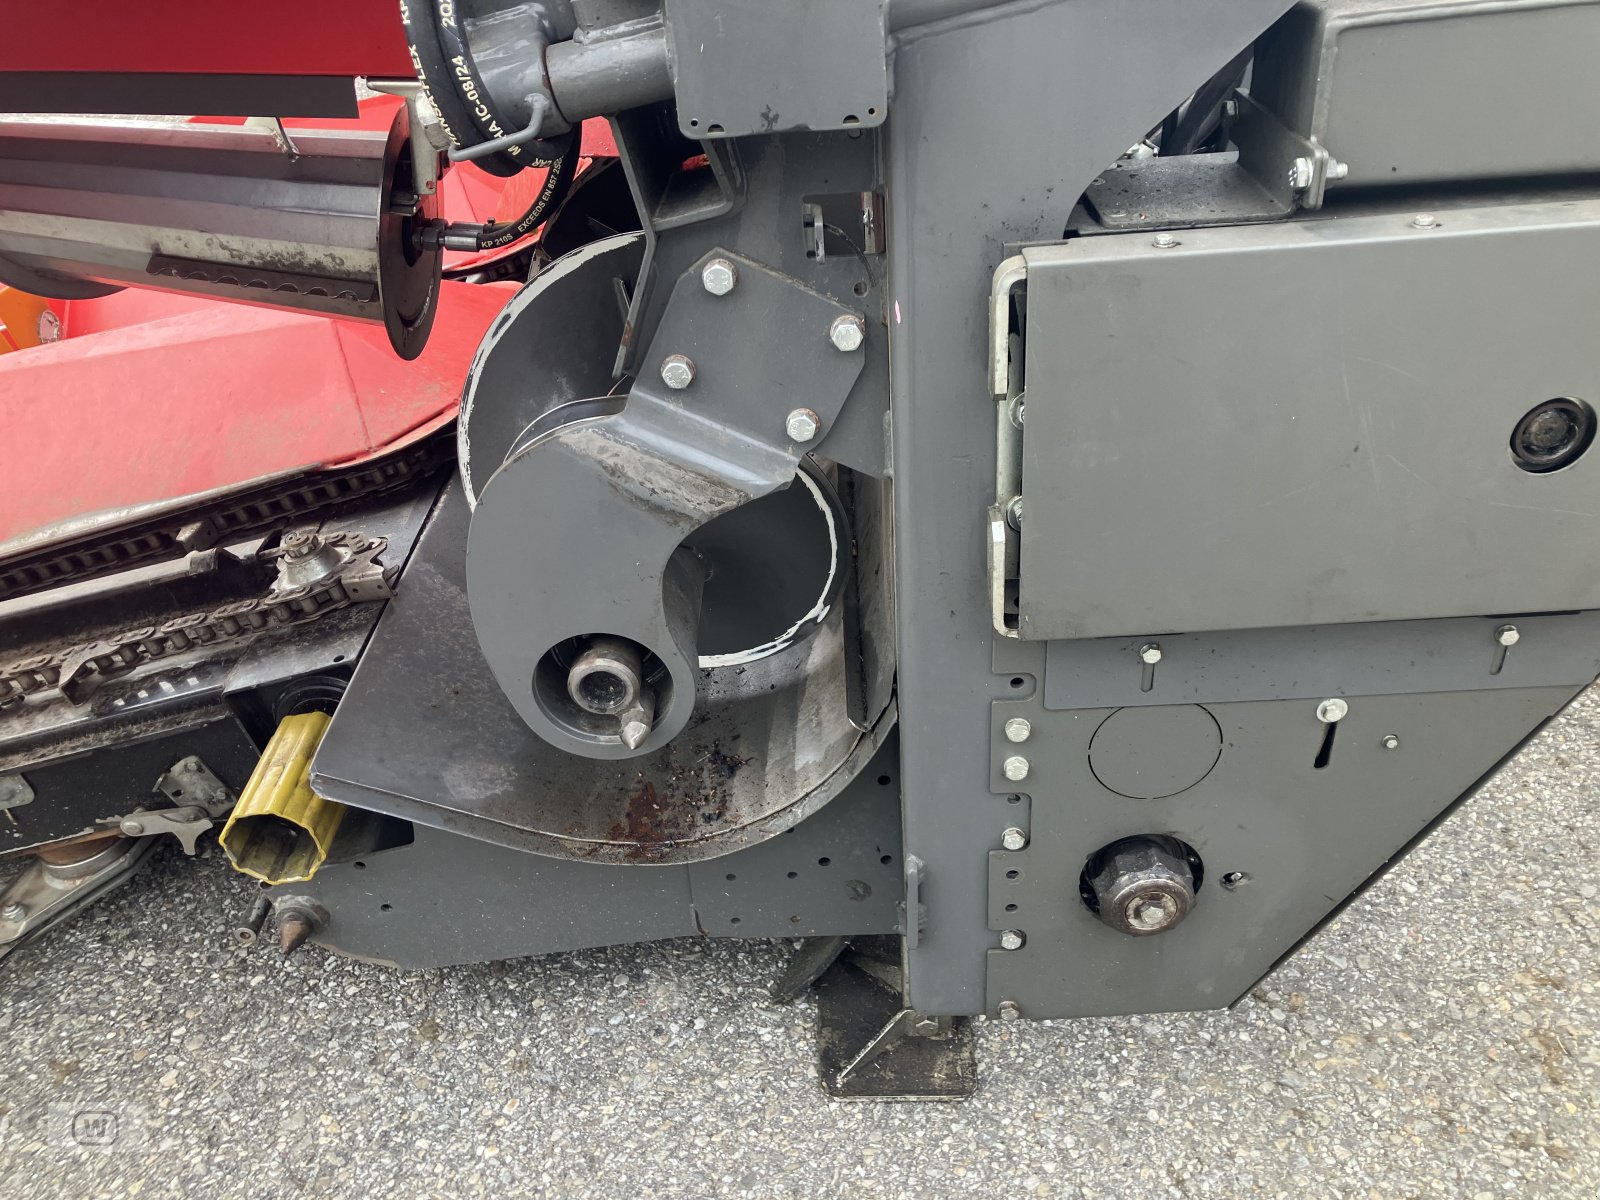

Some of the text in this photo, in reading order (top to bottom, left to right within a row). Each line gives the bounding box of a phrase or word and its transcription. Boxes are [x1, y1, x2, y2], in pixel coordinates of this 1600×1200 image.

[439, 0, 458, 27] 2Q
[451, 55, 492, 121] IC-08/24
[547, 174, 558, 190] 857
[542, 187, 553, 202] EN
[517, 201, 546, 232] EXCEEDS
[481, 240, 494, 249] KP
[495, 233, 514, 246] 210S
